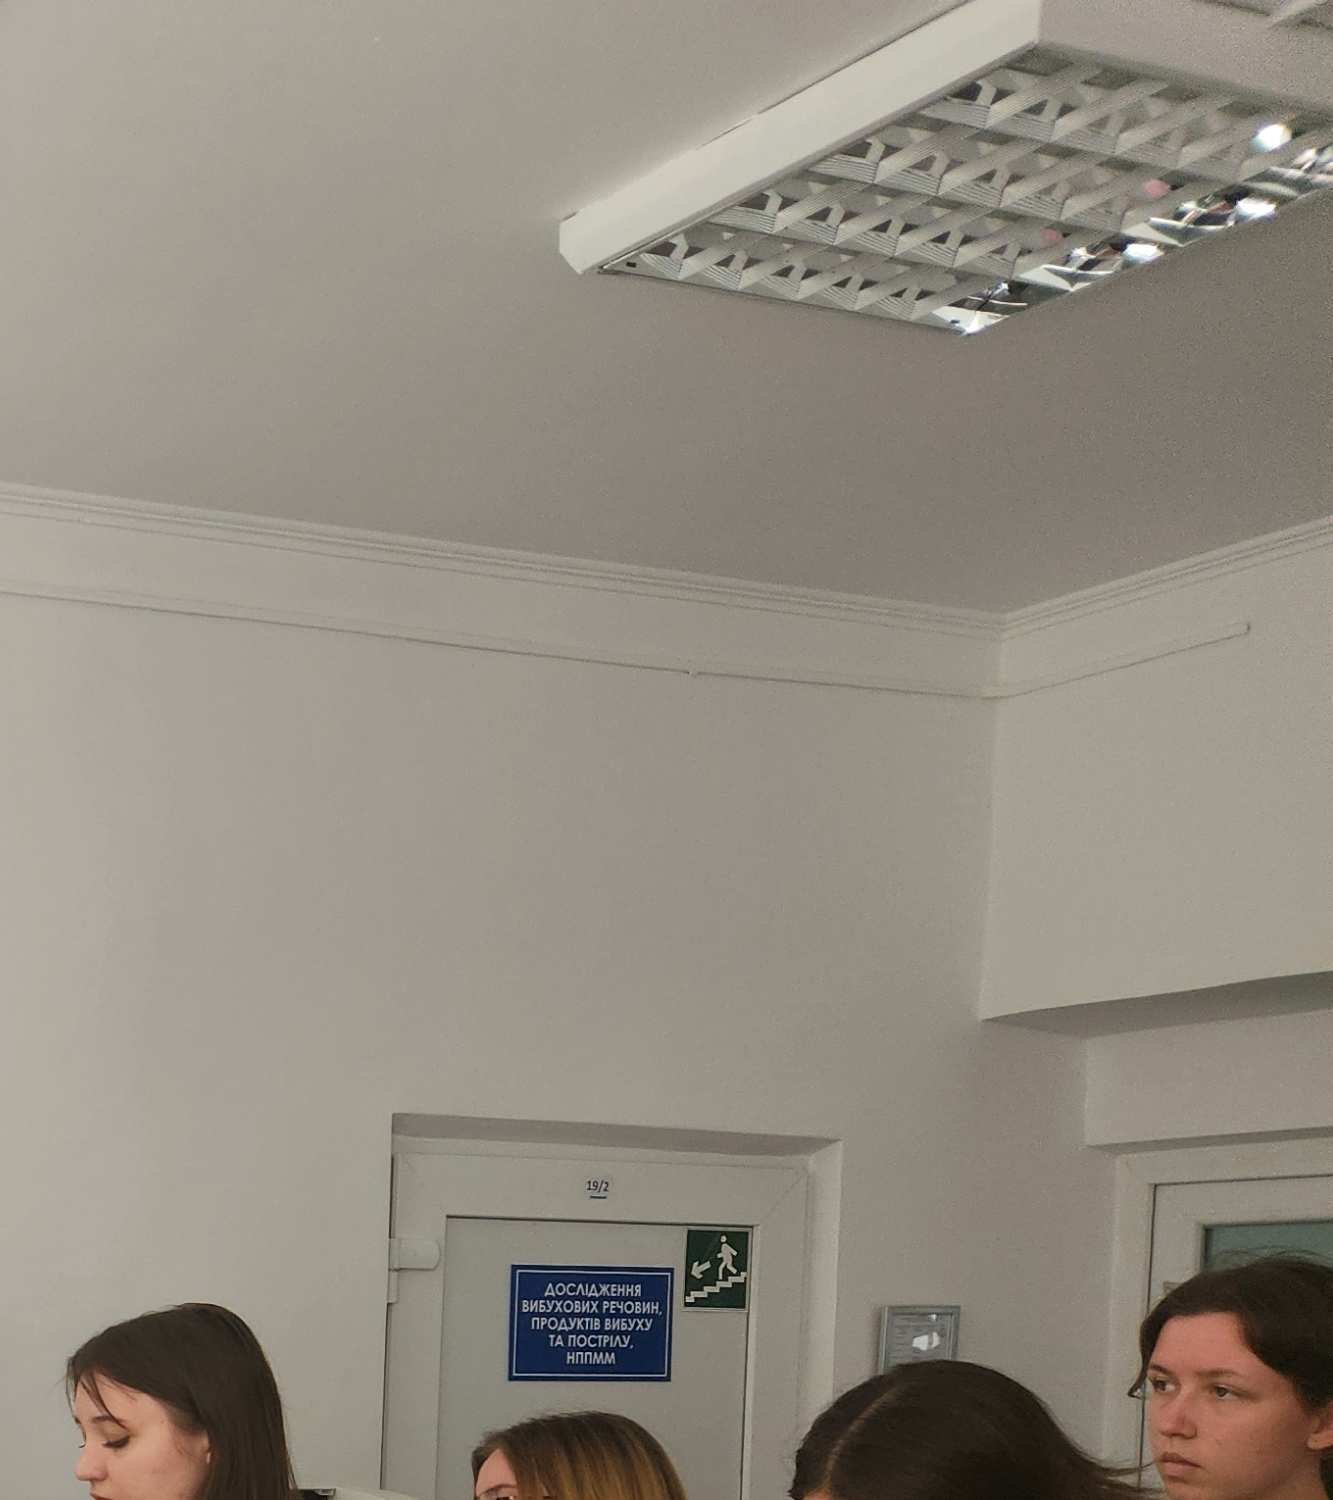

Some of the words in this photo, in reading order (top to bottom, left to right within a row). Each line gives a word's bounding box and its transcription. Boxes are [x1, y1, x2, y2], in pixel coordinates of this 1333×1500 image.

[586, 1179, 609, 1193] 19/2
[544, 1282, 642, 1297] ДОСЛІДЖЕННЯ
[521, 1300, 599, 1314] ВИБУХОВИХ
[602, 1301, 663, 1316] РЕЧОВИН,
[531, 1317, 601, 1331] ПРОДУКТІВ
[604, 1318, 653, 1331] ВИБУХУ
[548, 1334, 564, 1347] ТА
[567, 1334, 634, 1350] ПОСТРІЛУ,
[566, 1351, 616, 1365] НППММ
